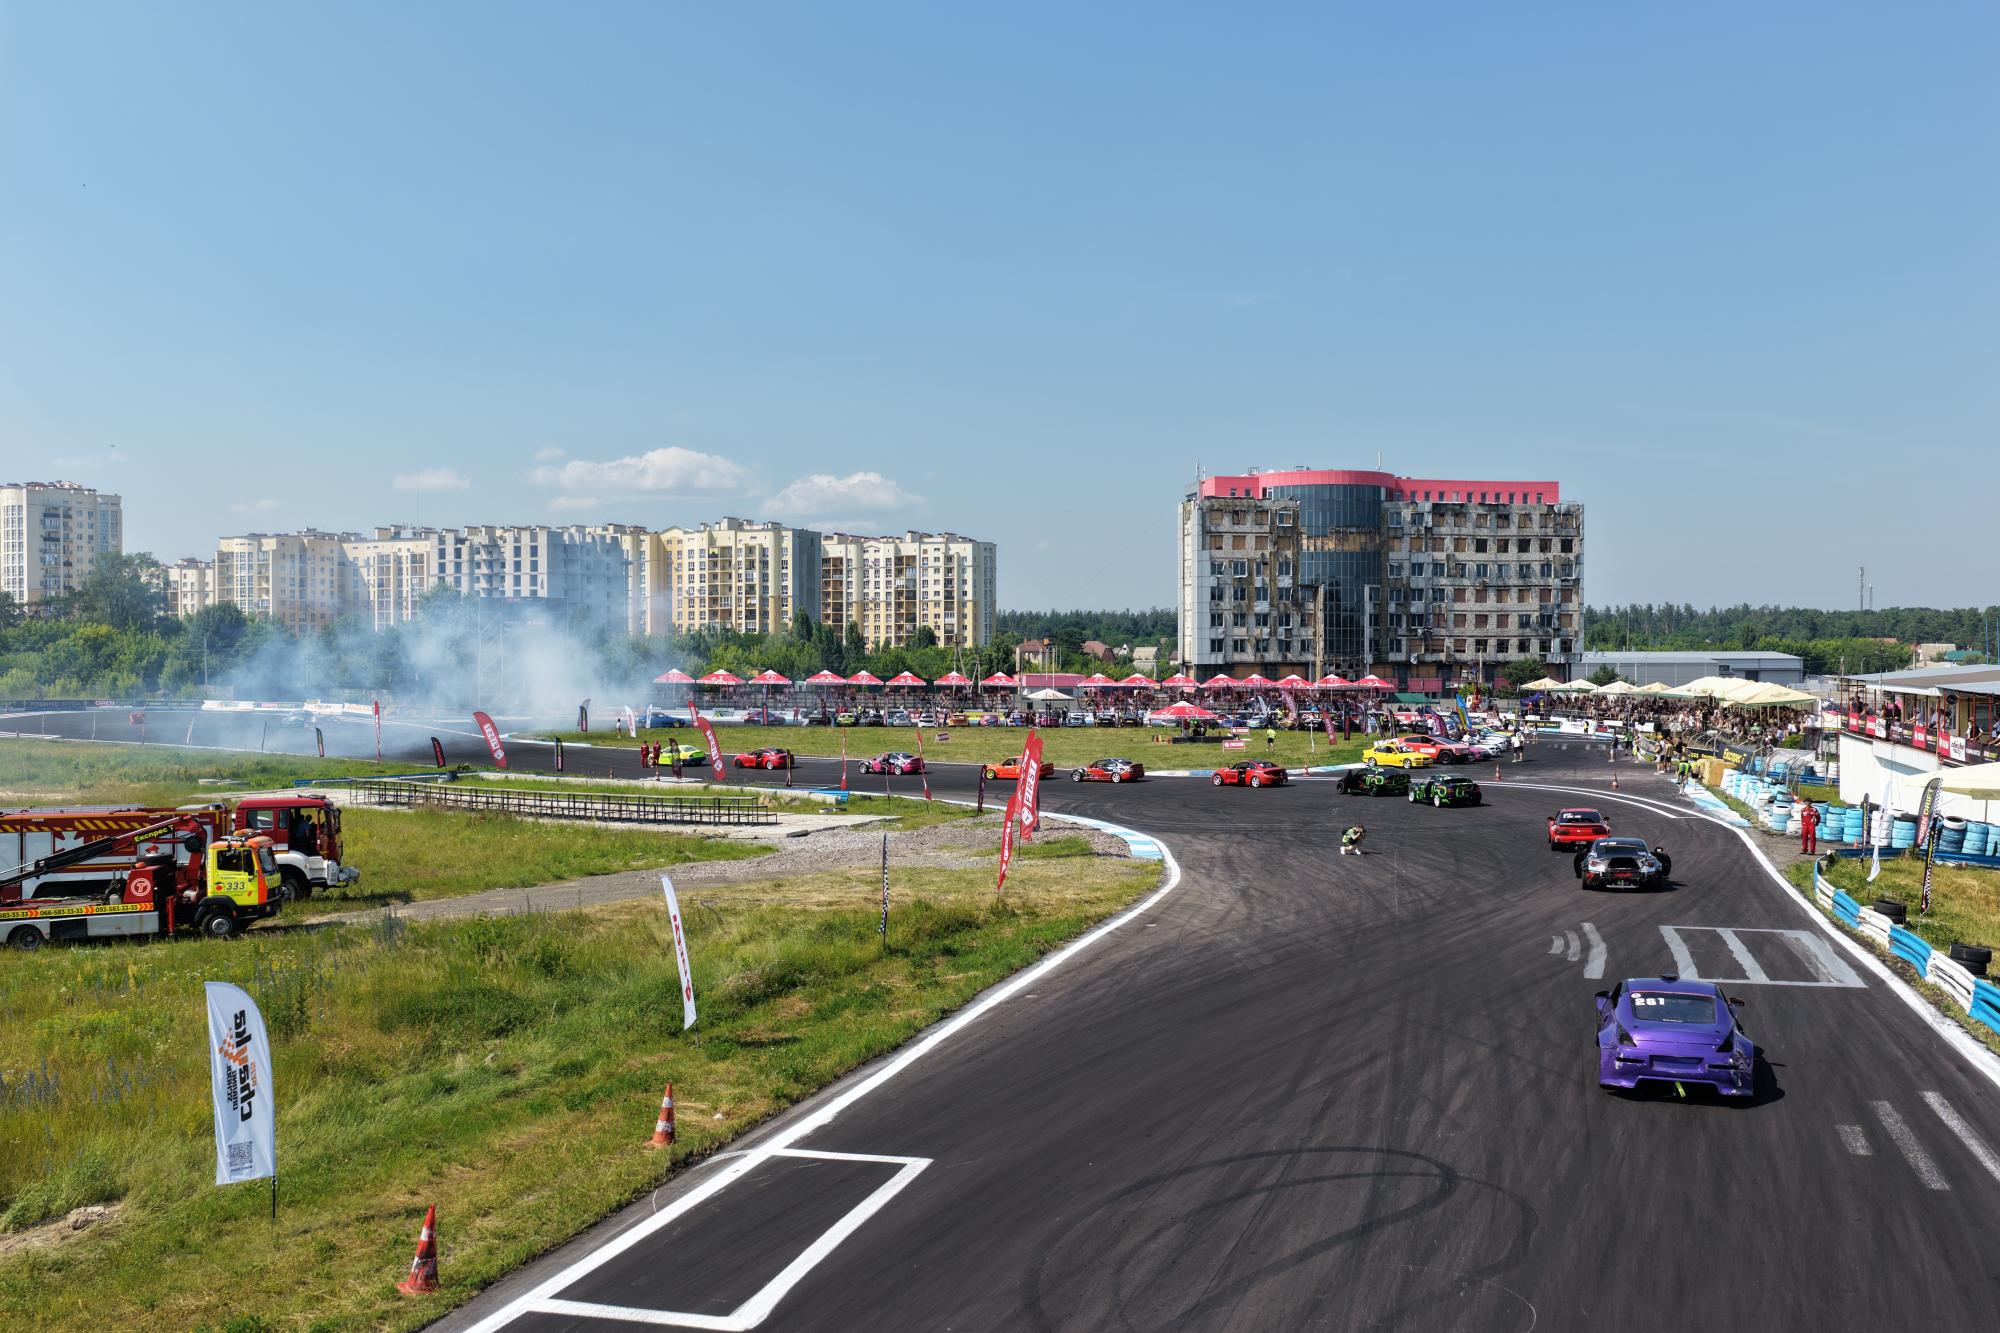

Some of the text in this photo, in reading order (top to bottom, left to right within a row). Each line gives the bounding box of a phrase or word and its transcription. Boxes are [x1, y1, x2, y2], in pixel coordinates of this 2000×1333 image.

[1024, 760, 1037, 806] FIRST
[1917, 787, 1934, 844] OPEN DRIFT
[134, 827, 168, 842] Експрес
[226, 882, 246, 891] 333
[95, 905, 138, 913] 093-583-33-33
[1635, 998, 1665, 1006] 261
